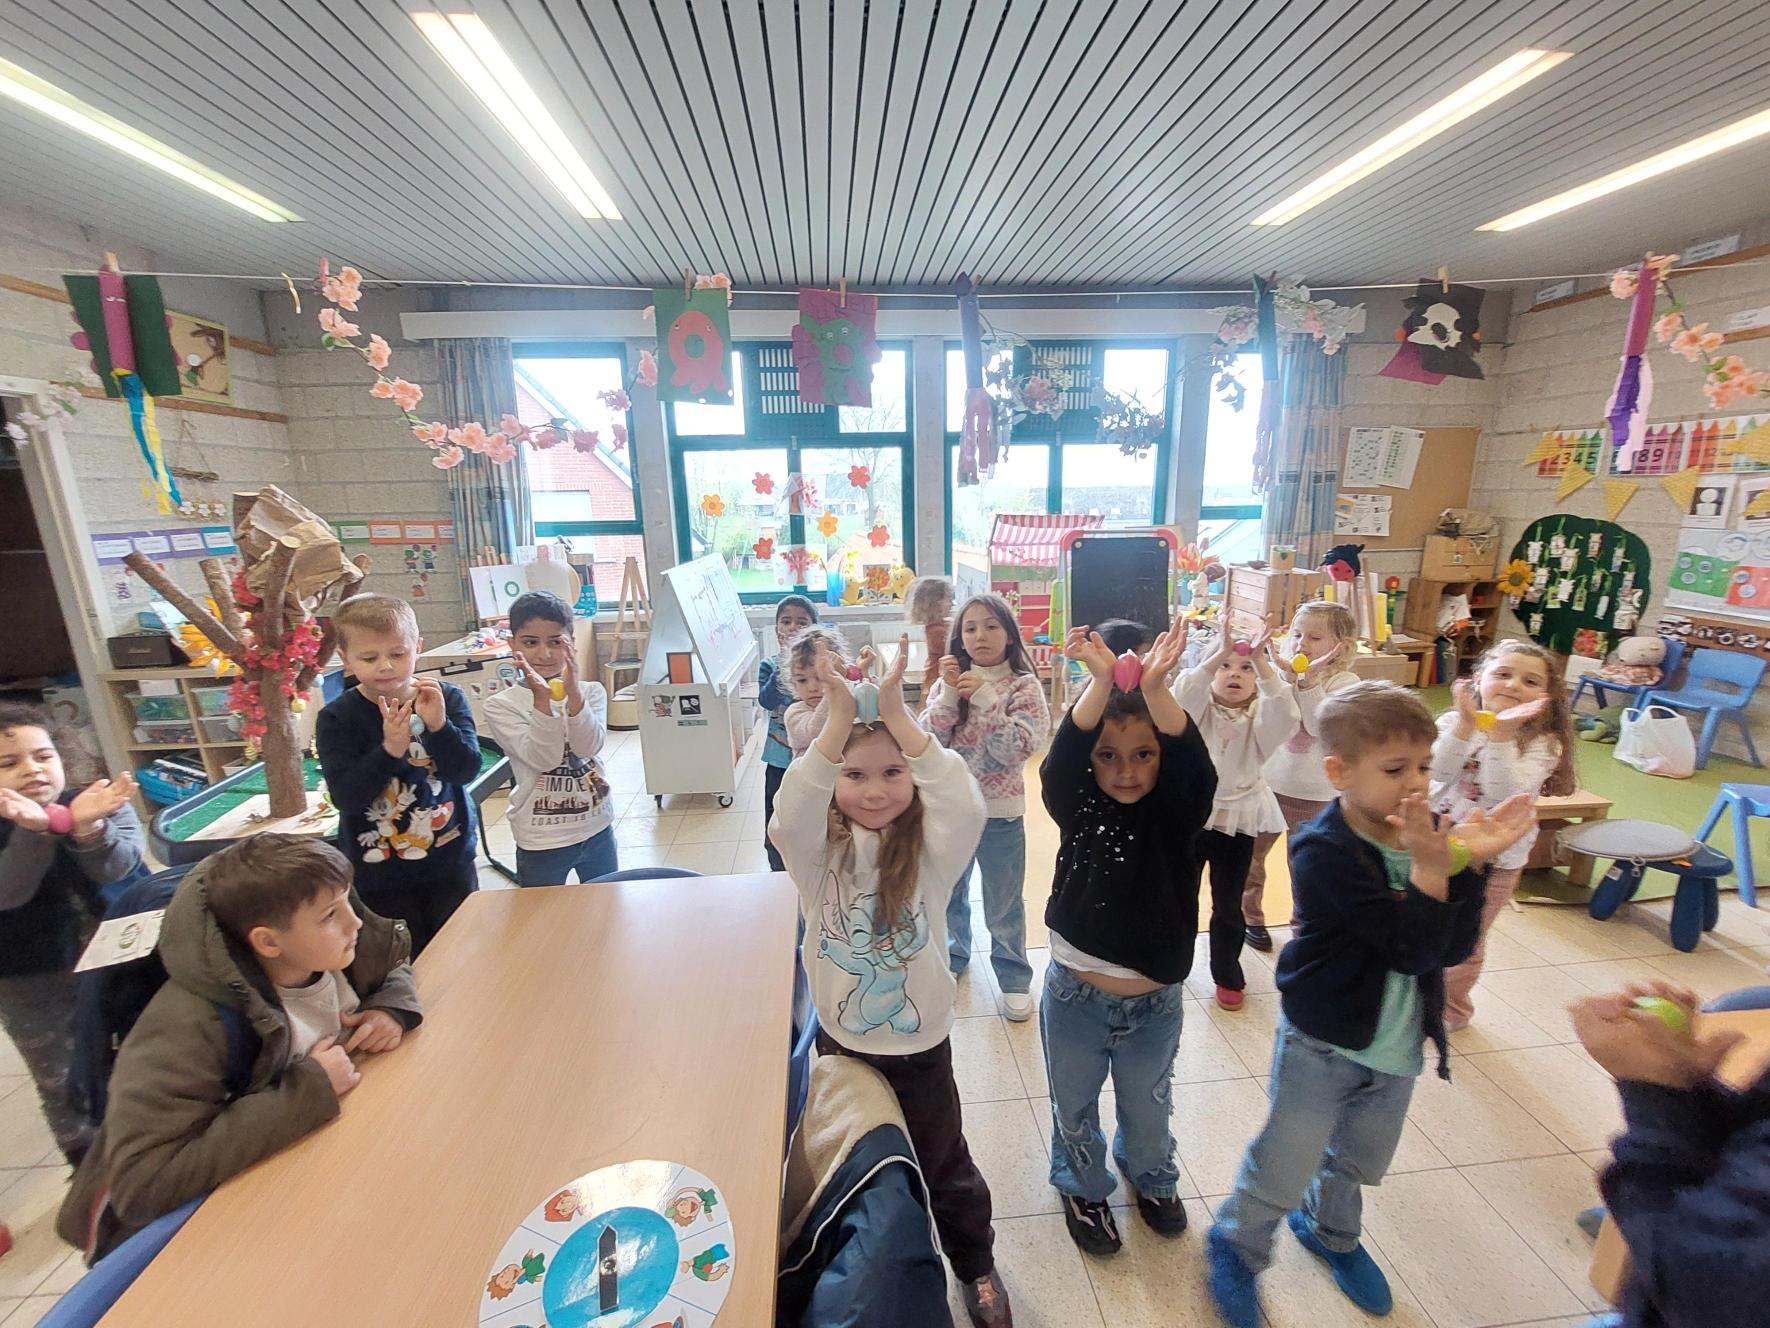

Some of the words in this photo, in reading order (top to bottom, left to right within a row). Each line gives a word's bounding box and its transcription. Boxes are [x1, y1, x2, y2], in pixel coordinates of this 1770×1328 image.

[1561, 452, 1571, 465] 3
[1573, 452, 1583, 465] 4
[1586, 451, 1597, 465] 5
[1638, 448, 1649, 463] 8
[1651, 448, 1664, 463] 9
[531, 816, 567, 827] COAST
